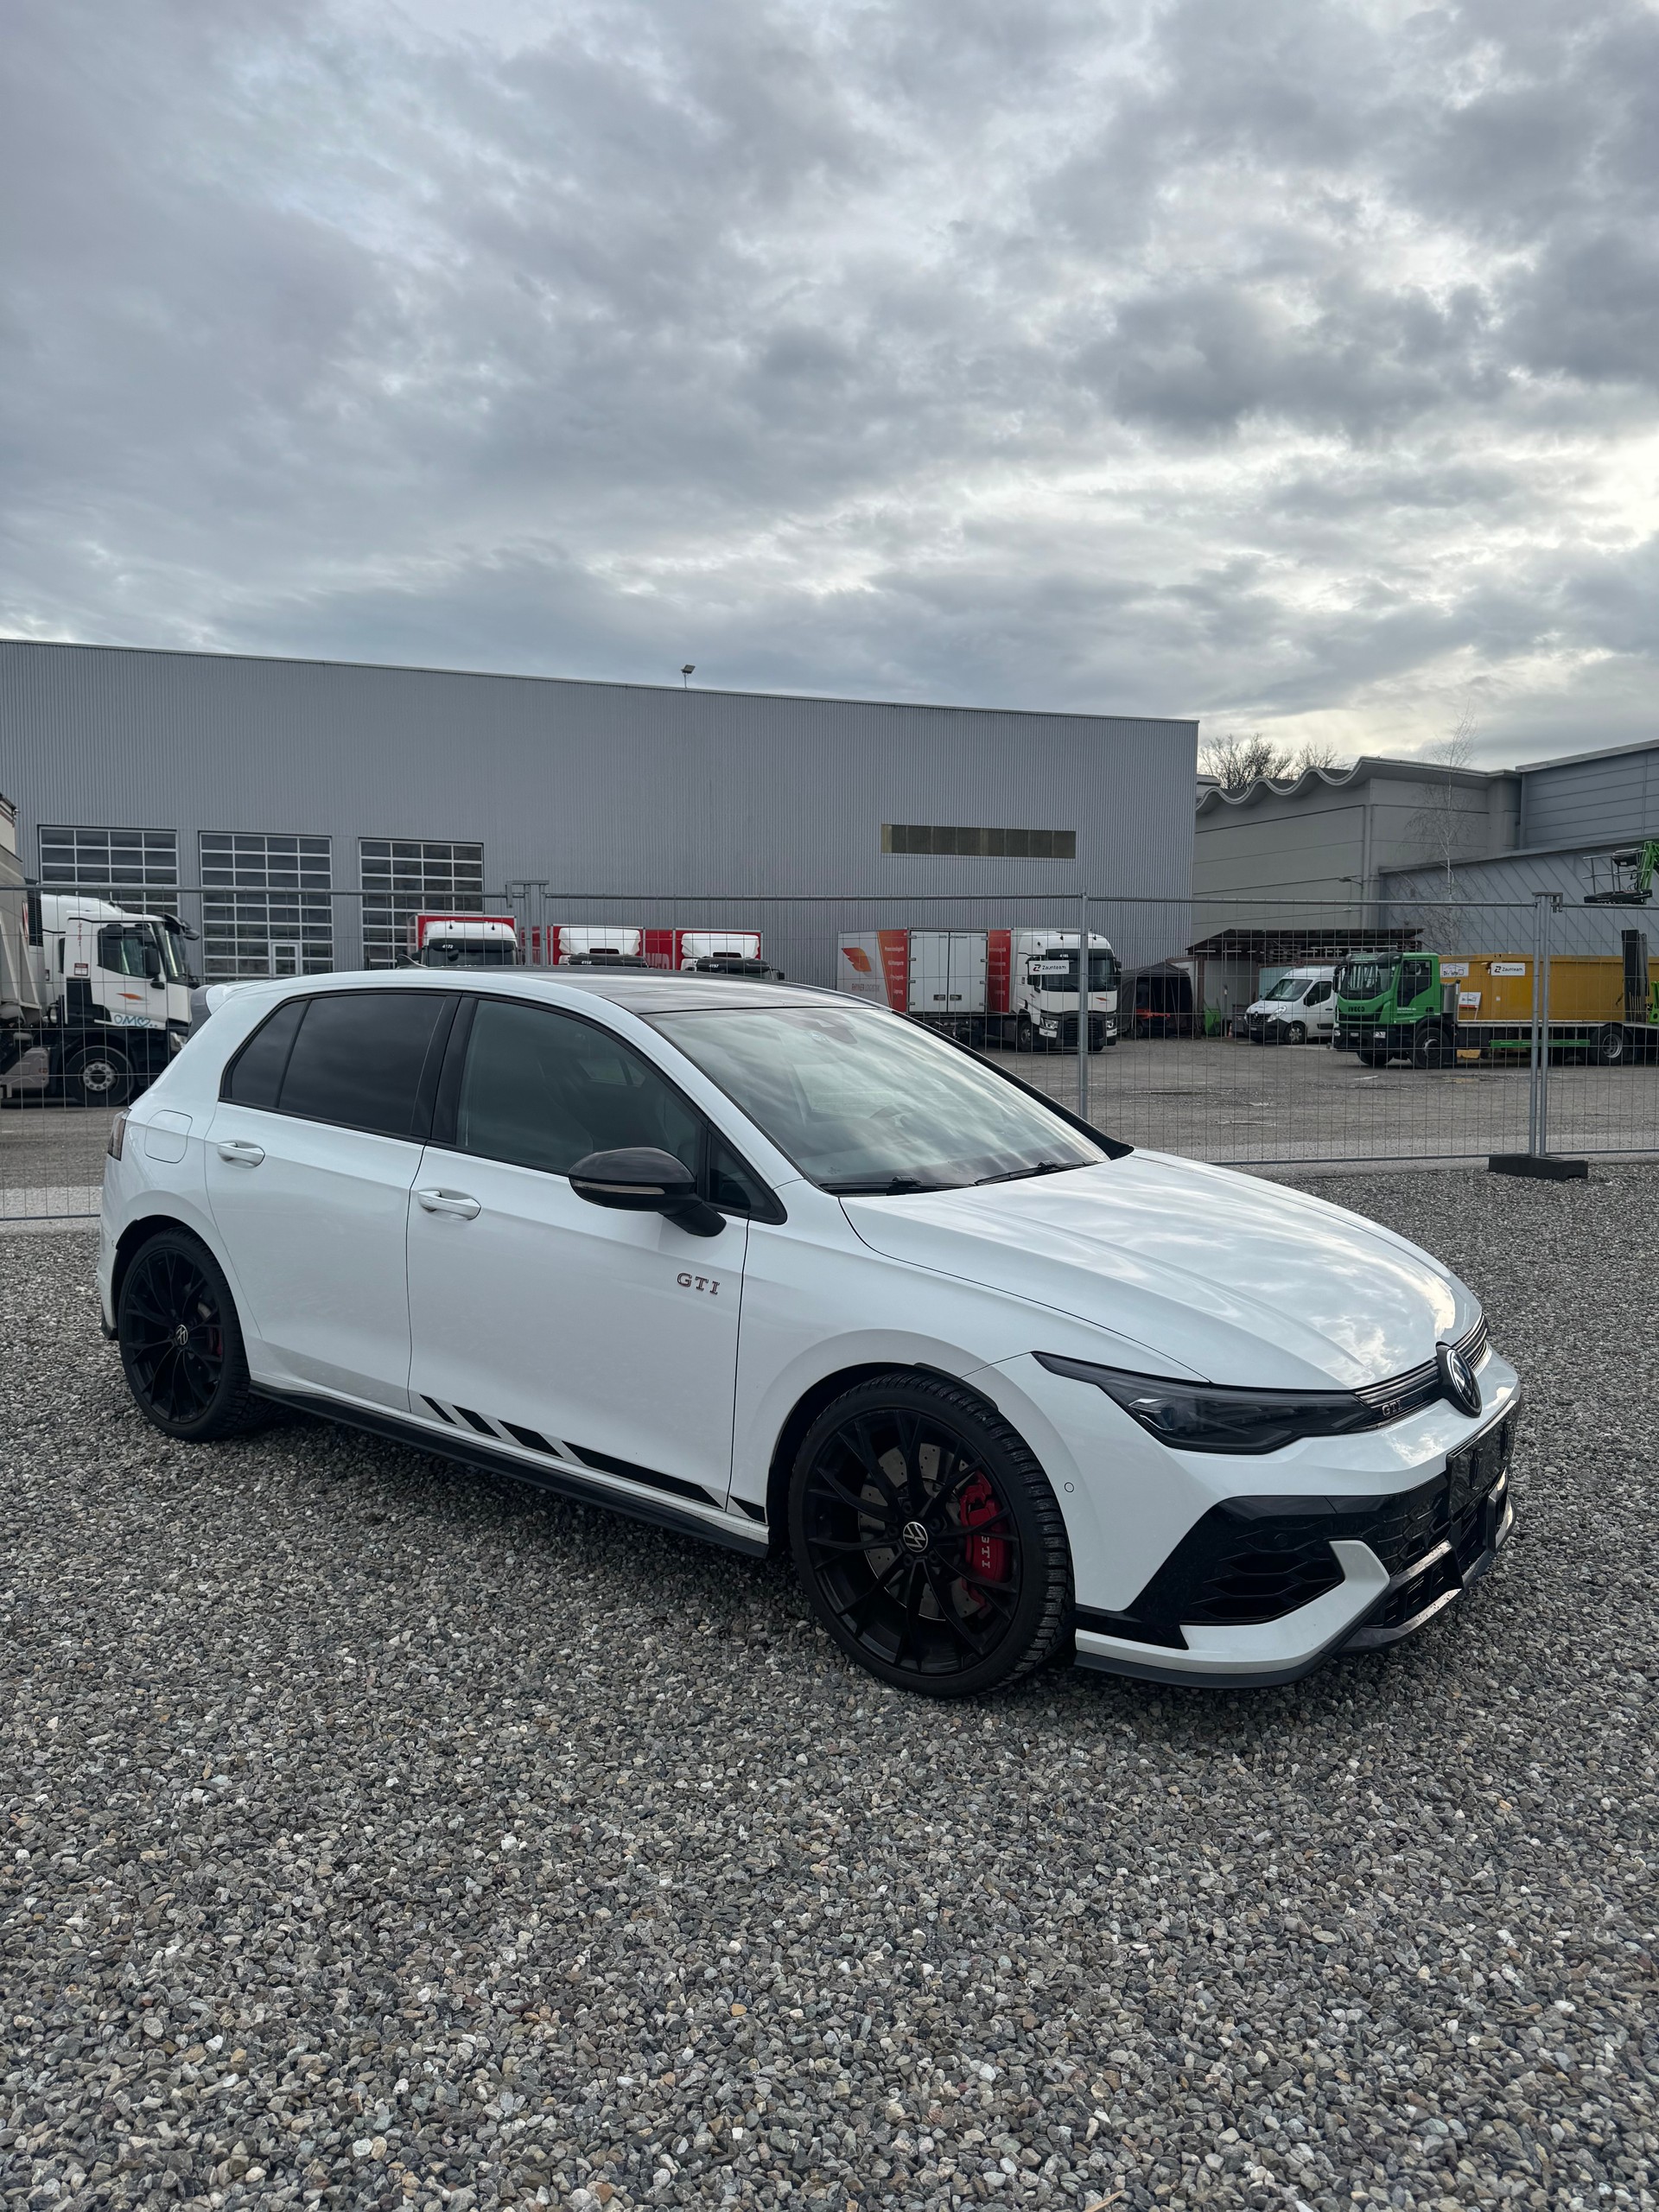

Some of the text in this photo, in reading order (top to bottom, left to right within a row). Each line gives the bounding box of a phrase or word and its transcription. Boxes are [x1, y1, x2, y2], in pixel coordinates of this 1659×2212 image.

[677, 1272, 720, 1295] GTI
[1382, 1400, 1403, 1417] GTI
[981, 1535, 991, 1569] GTI
